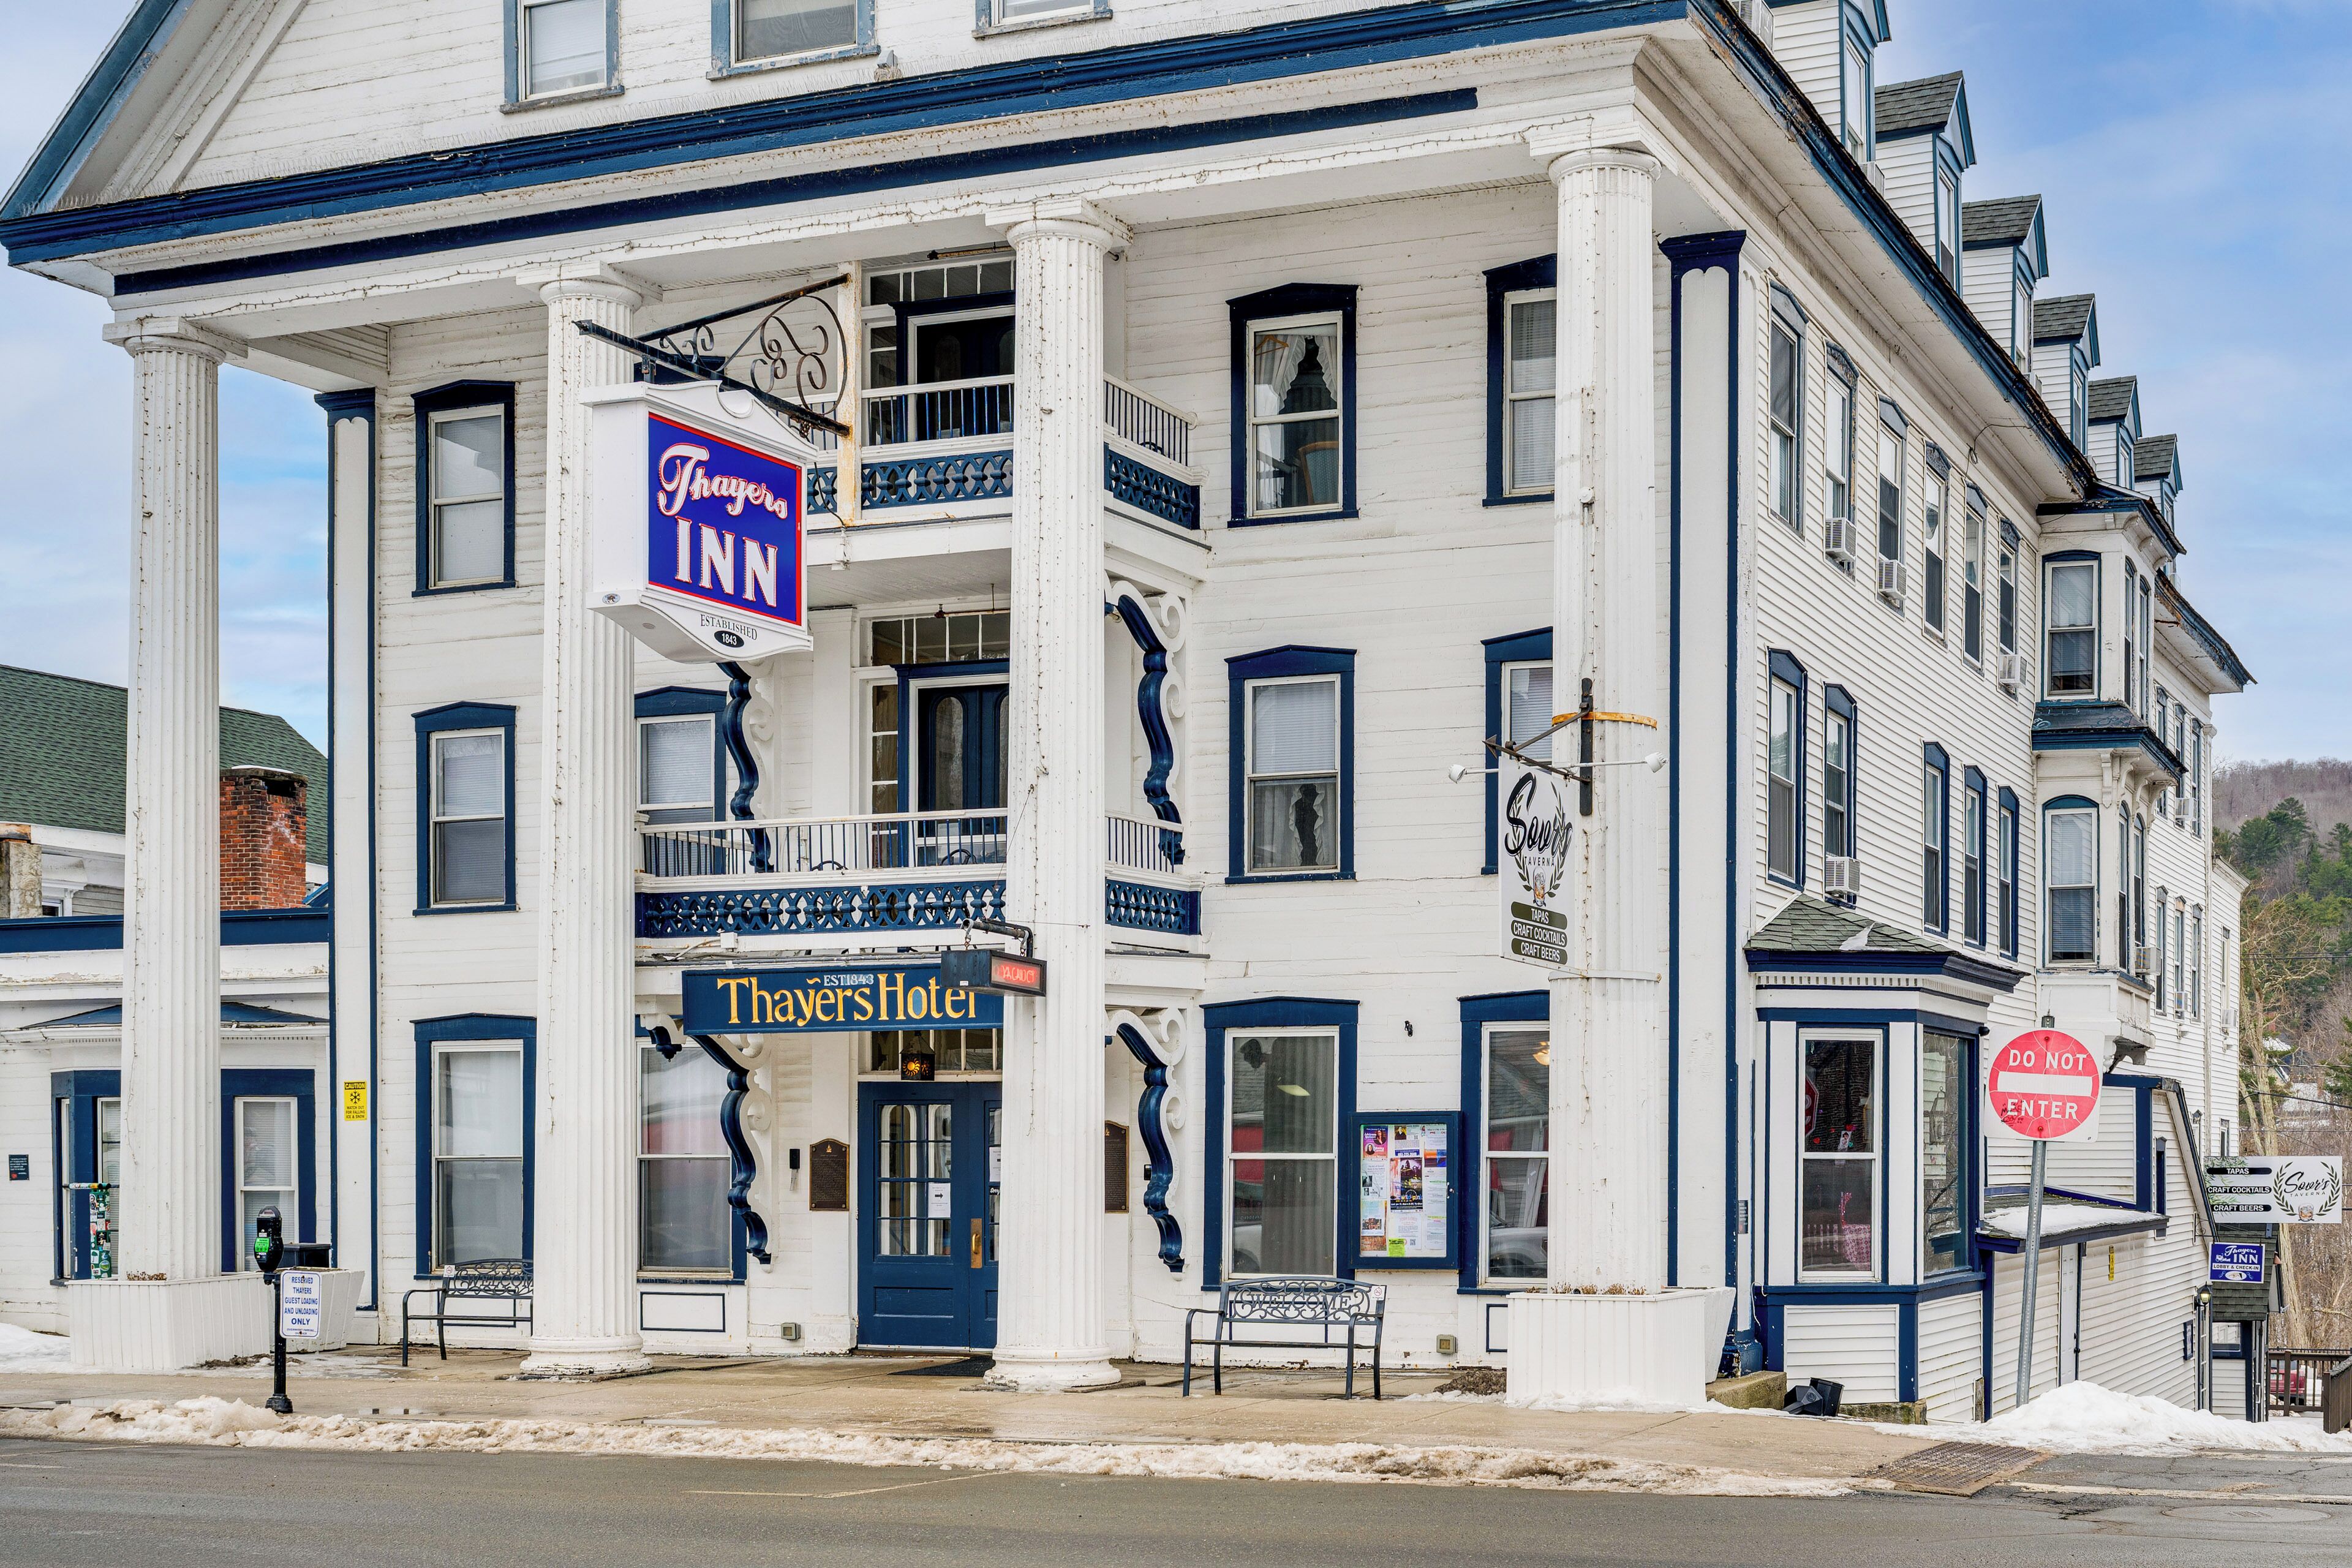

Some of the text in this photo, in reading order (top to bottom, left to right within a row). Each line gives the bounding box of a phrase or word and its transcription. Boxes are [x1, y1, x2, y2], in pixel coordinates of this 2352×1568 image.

[657, 443, 788, 519] Thayers
[675, 516, 777, 608] INN
[700, 614, 758, 641] ESTABLISHED
[721, 633, 737, 646] 1843
[1525, 856, 1555, 867] TAVERNA
[1531, 908, 1549, 924] TAPAS
[1513, 922, 1566, 946] CRAFT COCKTAILS
[1521, 941, 1560, 962] CRAFT BEERS
[878, 973, 977, 1021] Hotel
[2009, 1049, 2087, 1071] DO NOT
[2007, 1099, 2078, 1119] ENTER
[2224, 1245, 2256, 1256] Thayers
[2233, 1254, 2258, 1264] INN
[467, 1274, 533, 1287] WELCOM
[1250, 1294, 1352, 1310] WELCOME
